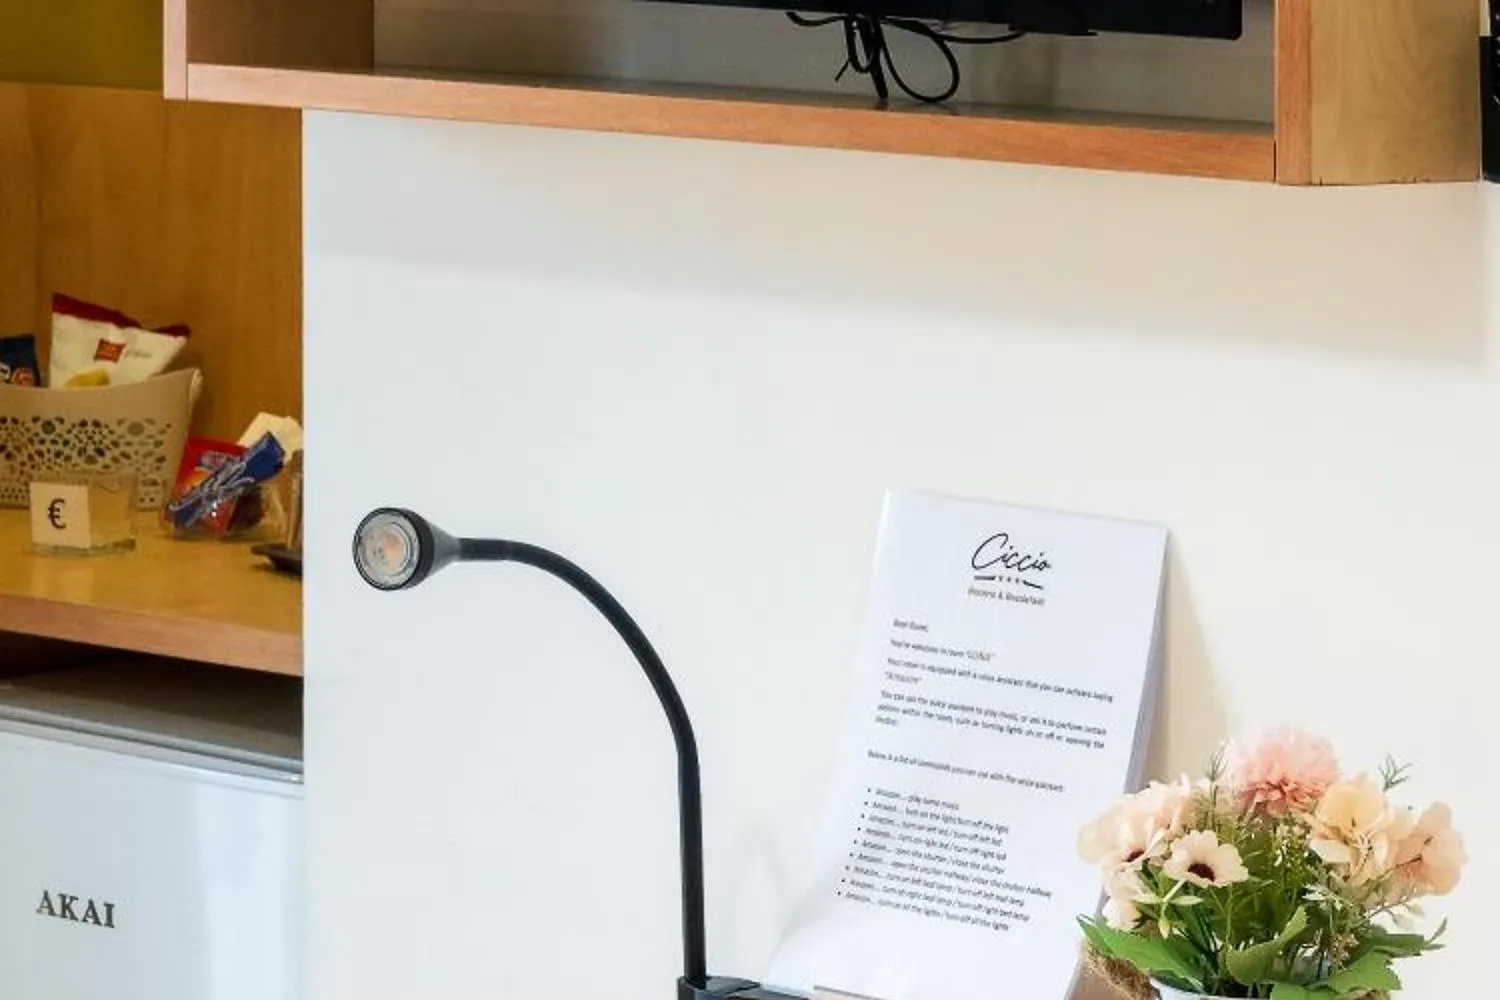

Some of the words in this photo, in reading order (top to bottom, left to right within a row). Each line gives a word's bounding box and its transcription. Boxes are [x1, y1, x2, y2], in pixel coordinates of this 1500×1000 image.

[47, 498, 67, 530] €
[972, 533, 1051, 571] Ciccio
[36, 889, 115, 929] AKAI
